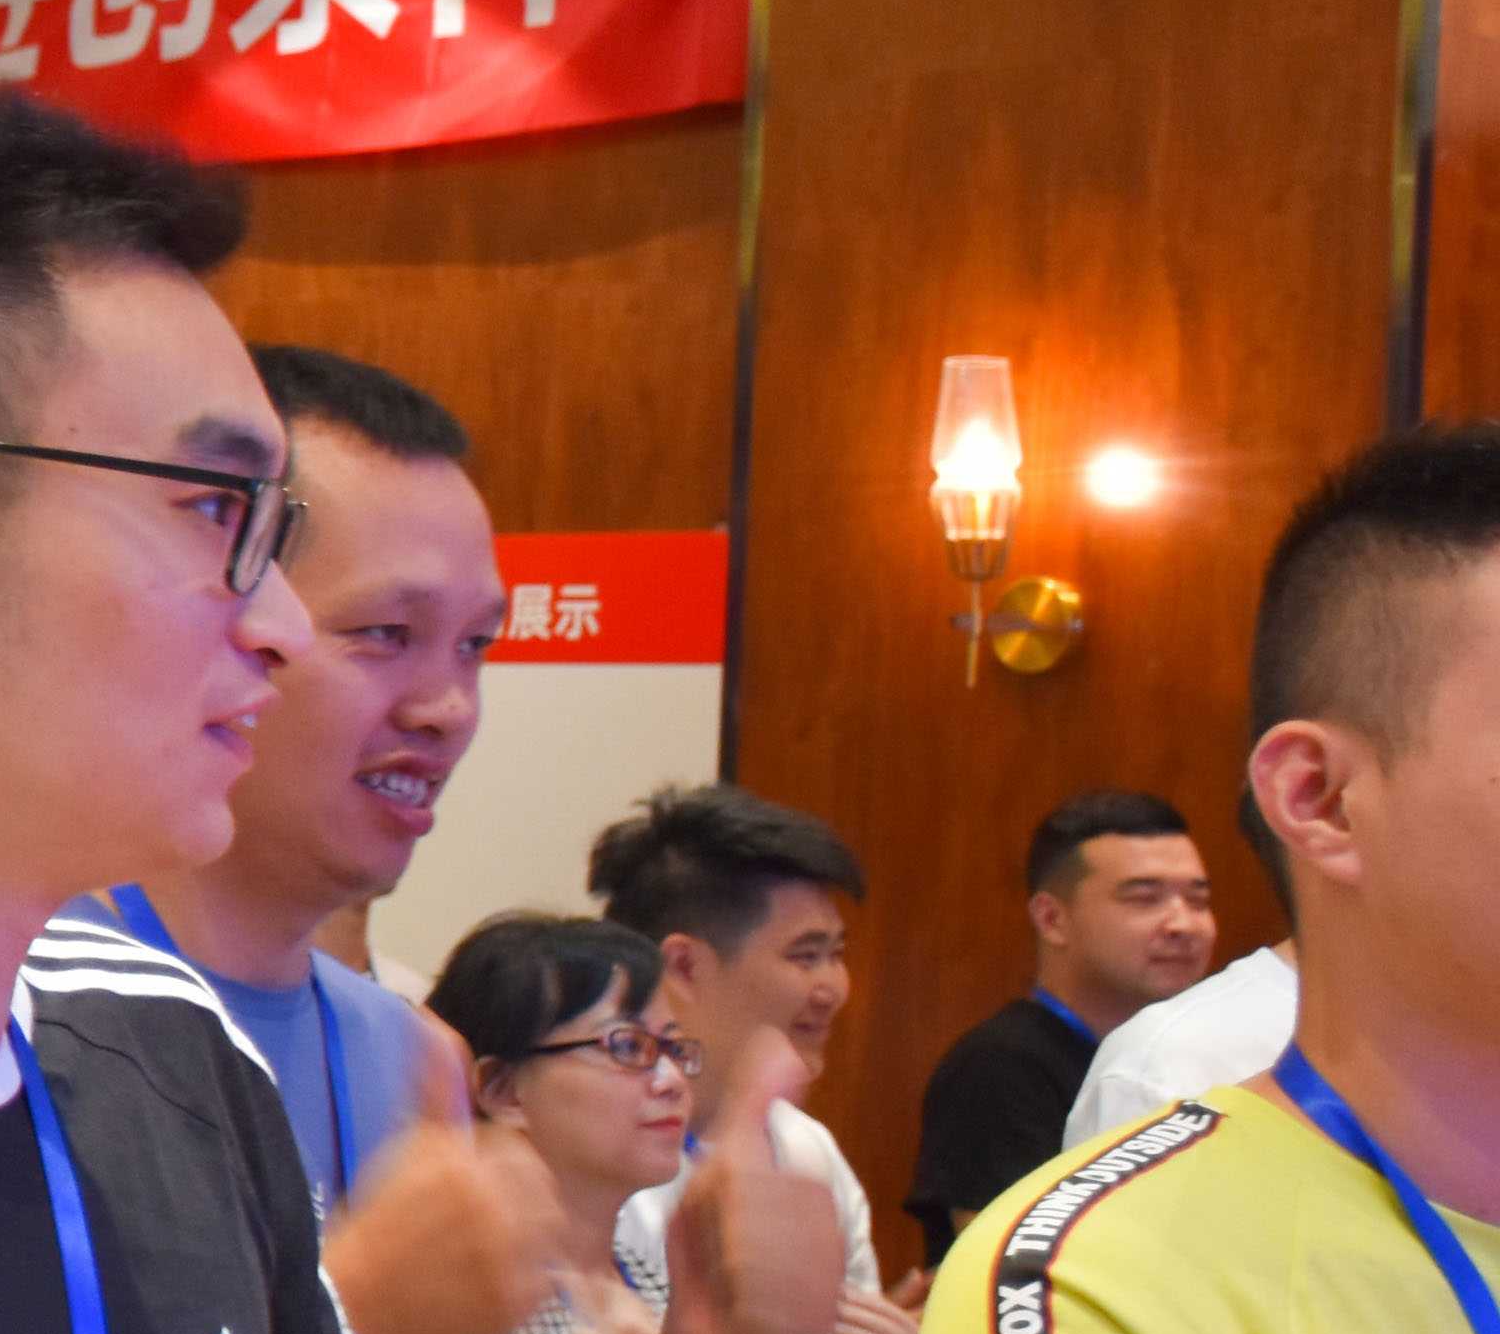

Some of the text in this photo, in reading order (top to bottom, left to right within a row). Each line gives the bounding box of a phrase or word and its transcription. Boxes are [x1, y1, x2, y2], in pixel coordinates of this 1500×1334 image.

[493, 582, 604, 642] 展示
[1004, 1179, 1102, 1255] THINK
[1073, 1112, 1212, 1183] OUTSIDE
